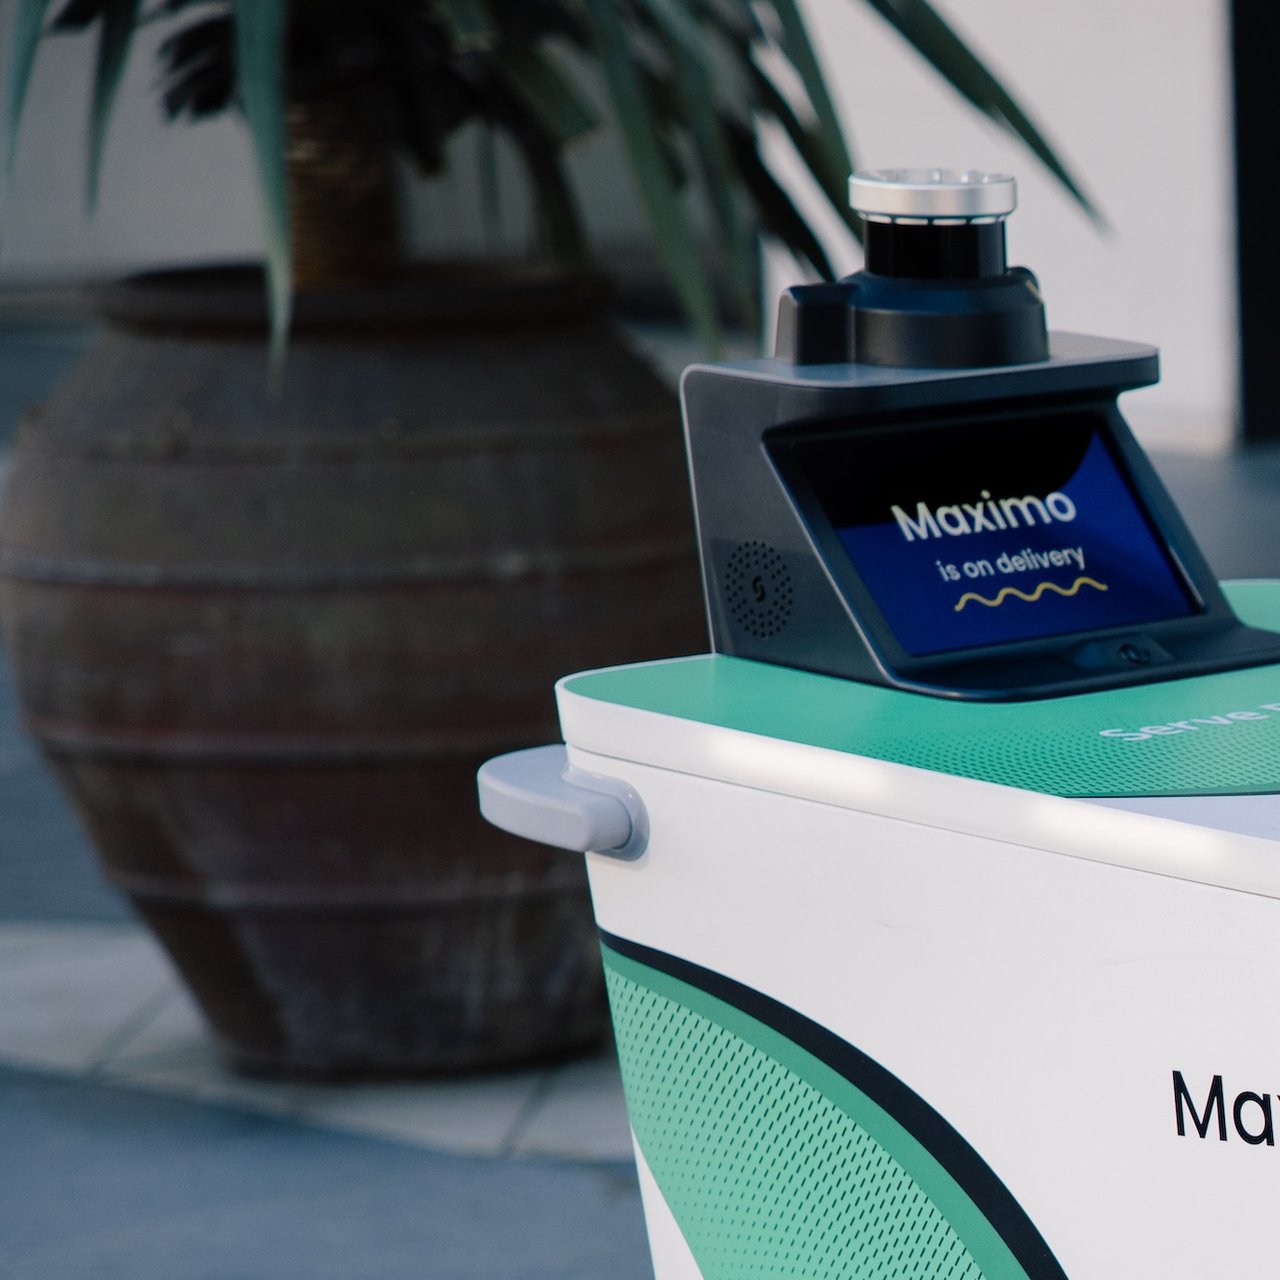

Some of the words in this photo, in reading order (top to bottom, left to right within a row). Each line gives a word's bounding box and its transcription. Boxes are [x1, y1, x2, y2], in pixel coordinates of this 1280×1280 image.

[890, 489, 1077, 542] Maximo
[935, 560, 961, 582] is
[963, 559, 995, 579] on
[996, 546, 1085, 573] delivery
[1099, 708, 1271, 742] Serve
